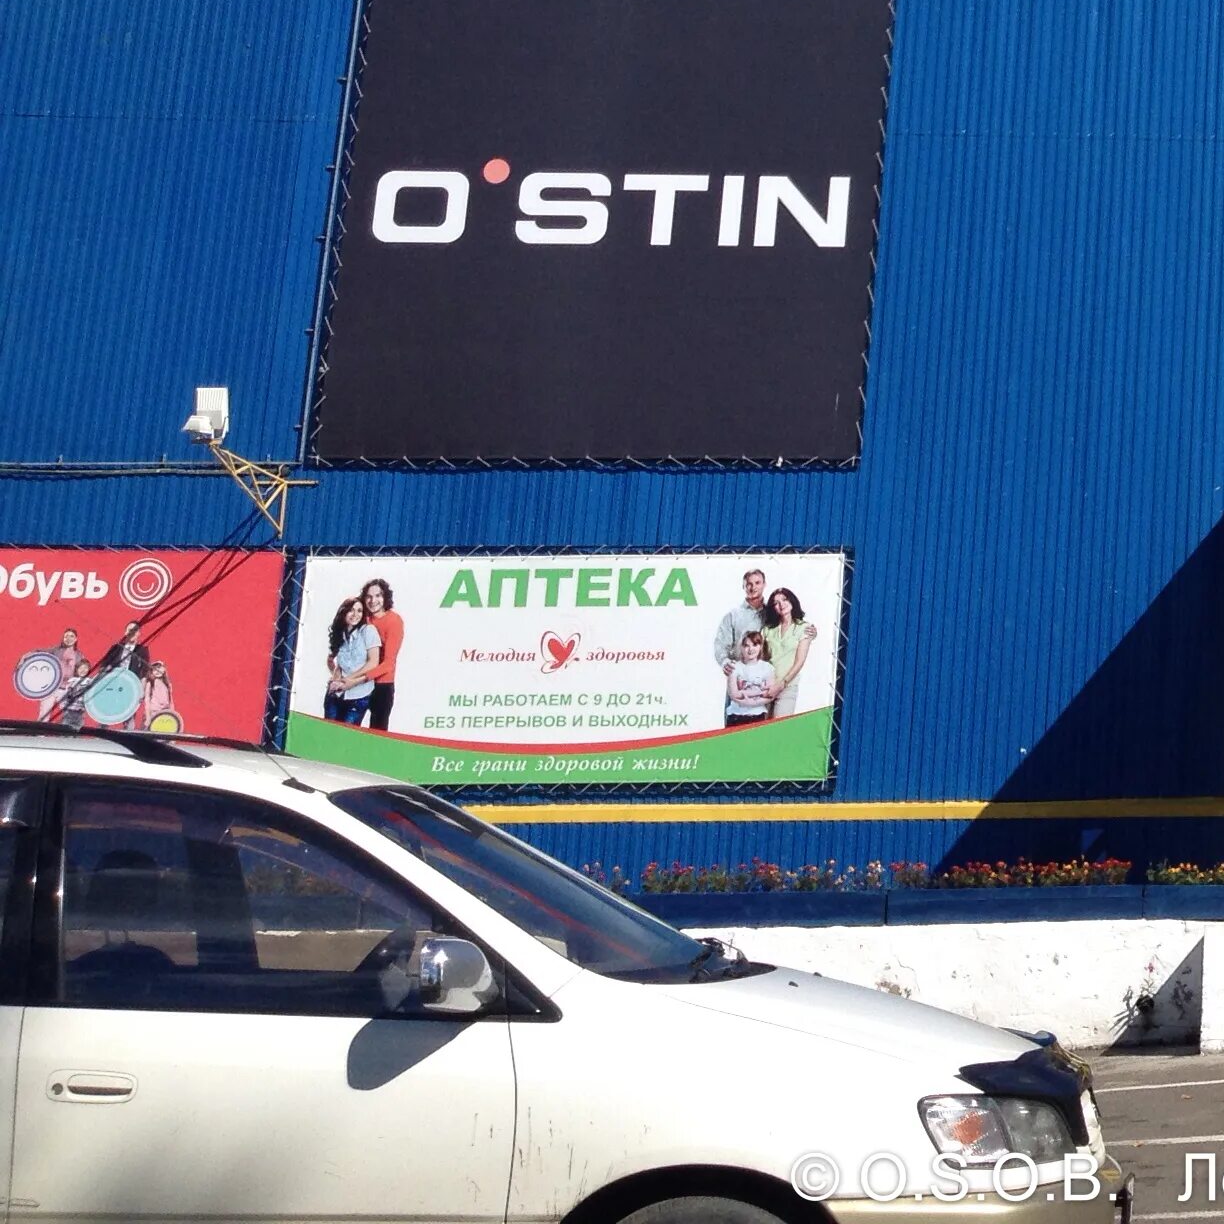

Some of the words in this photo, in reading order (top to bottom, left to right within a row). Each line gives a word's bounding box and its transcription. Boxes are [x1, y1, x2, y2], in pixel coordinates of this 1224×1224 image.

[439, 568, 698, 609] АПТЕКА
[459, 648, 536, 663] Мелодия
[586, 646, 665, 664] здоровья
[448, 694, 478, 707] МЫ
[483, 694, 572, 707] РАБОТАЕМ
[577, 693, 588, 706] С
[593, 693, 602, 706] 9
[606, 693, 631, 708] ДО
[424, 716, 455, 729] БЕЗ
[461, 715, 567, 728] ПЕРЕРЫВОВ
[572, 715, 583, 727] И
[589, 714, 689, 729] ВЫХОДНЫХ
[431, 756, 465, 772] Все
[471, 759, 528, 776] грани
[534, 756, 624, 775] здоровой
[632, 754, 700, 772] жизни!
